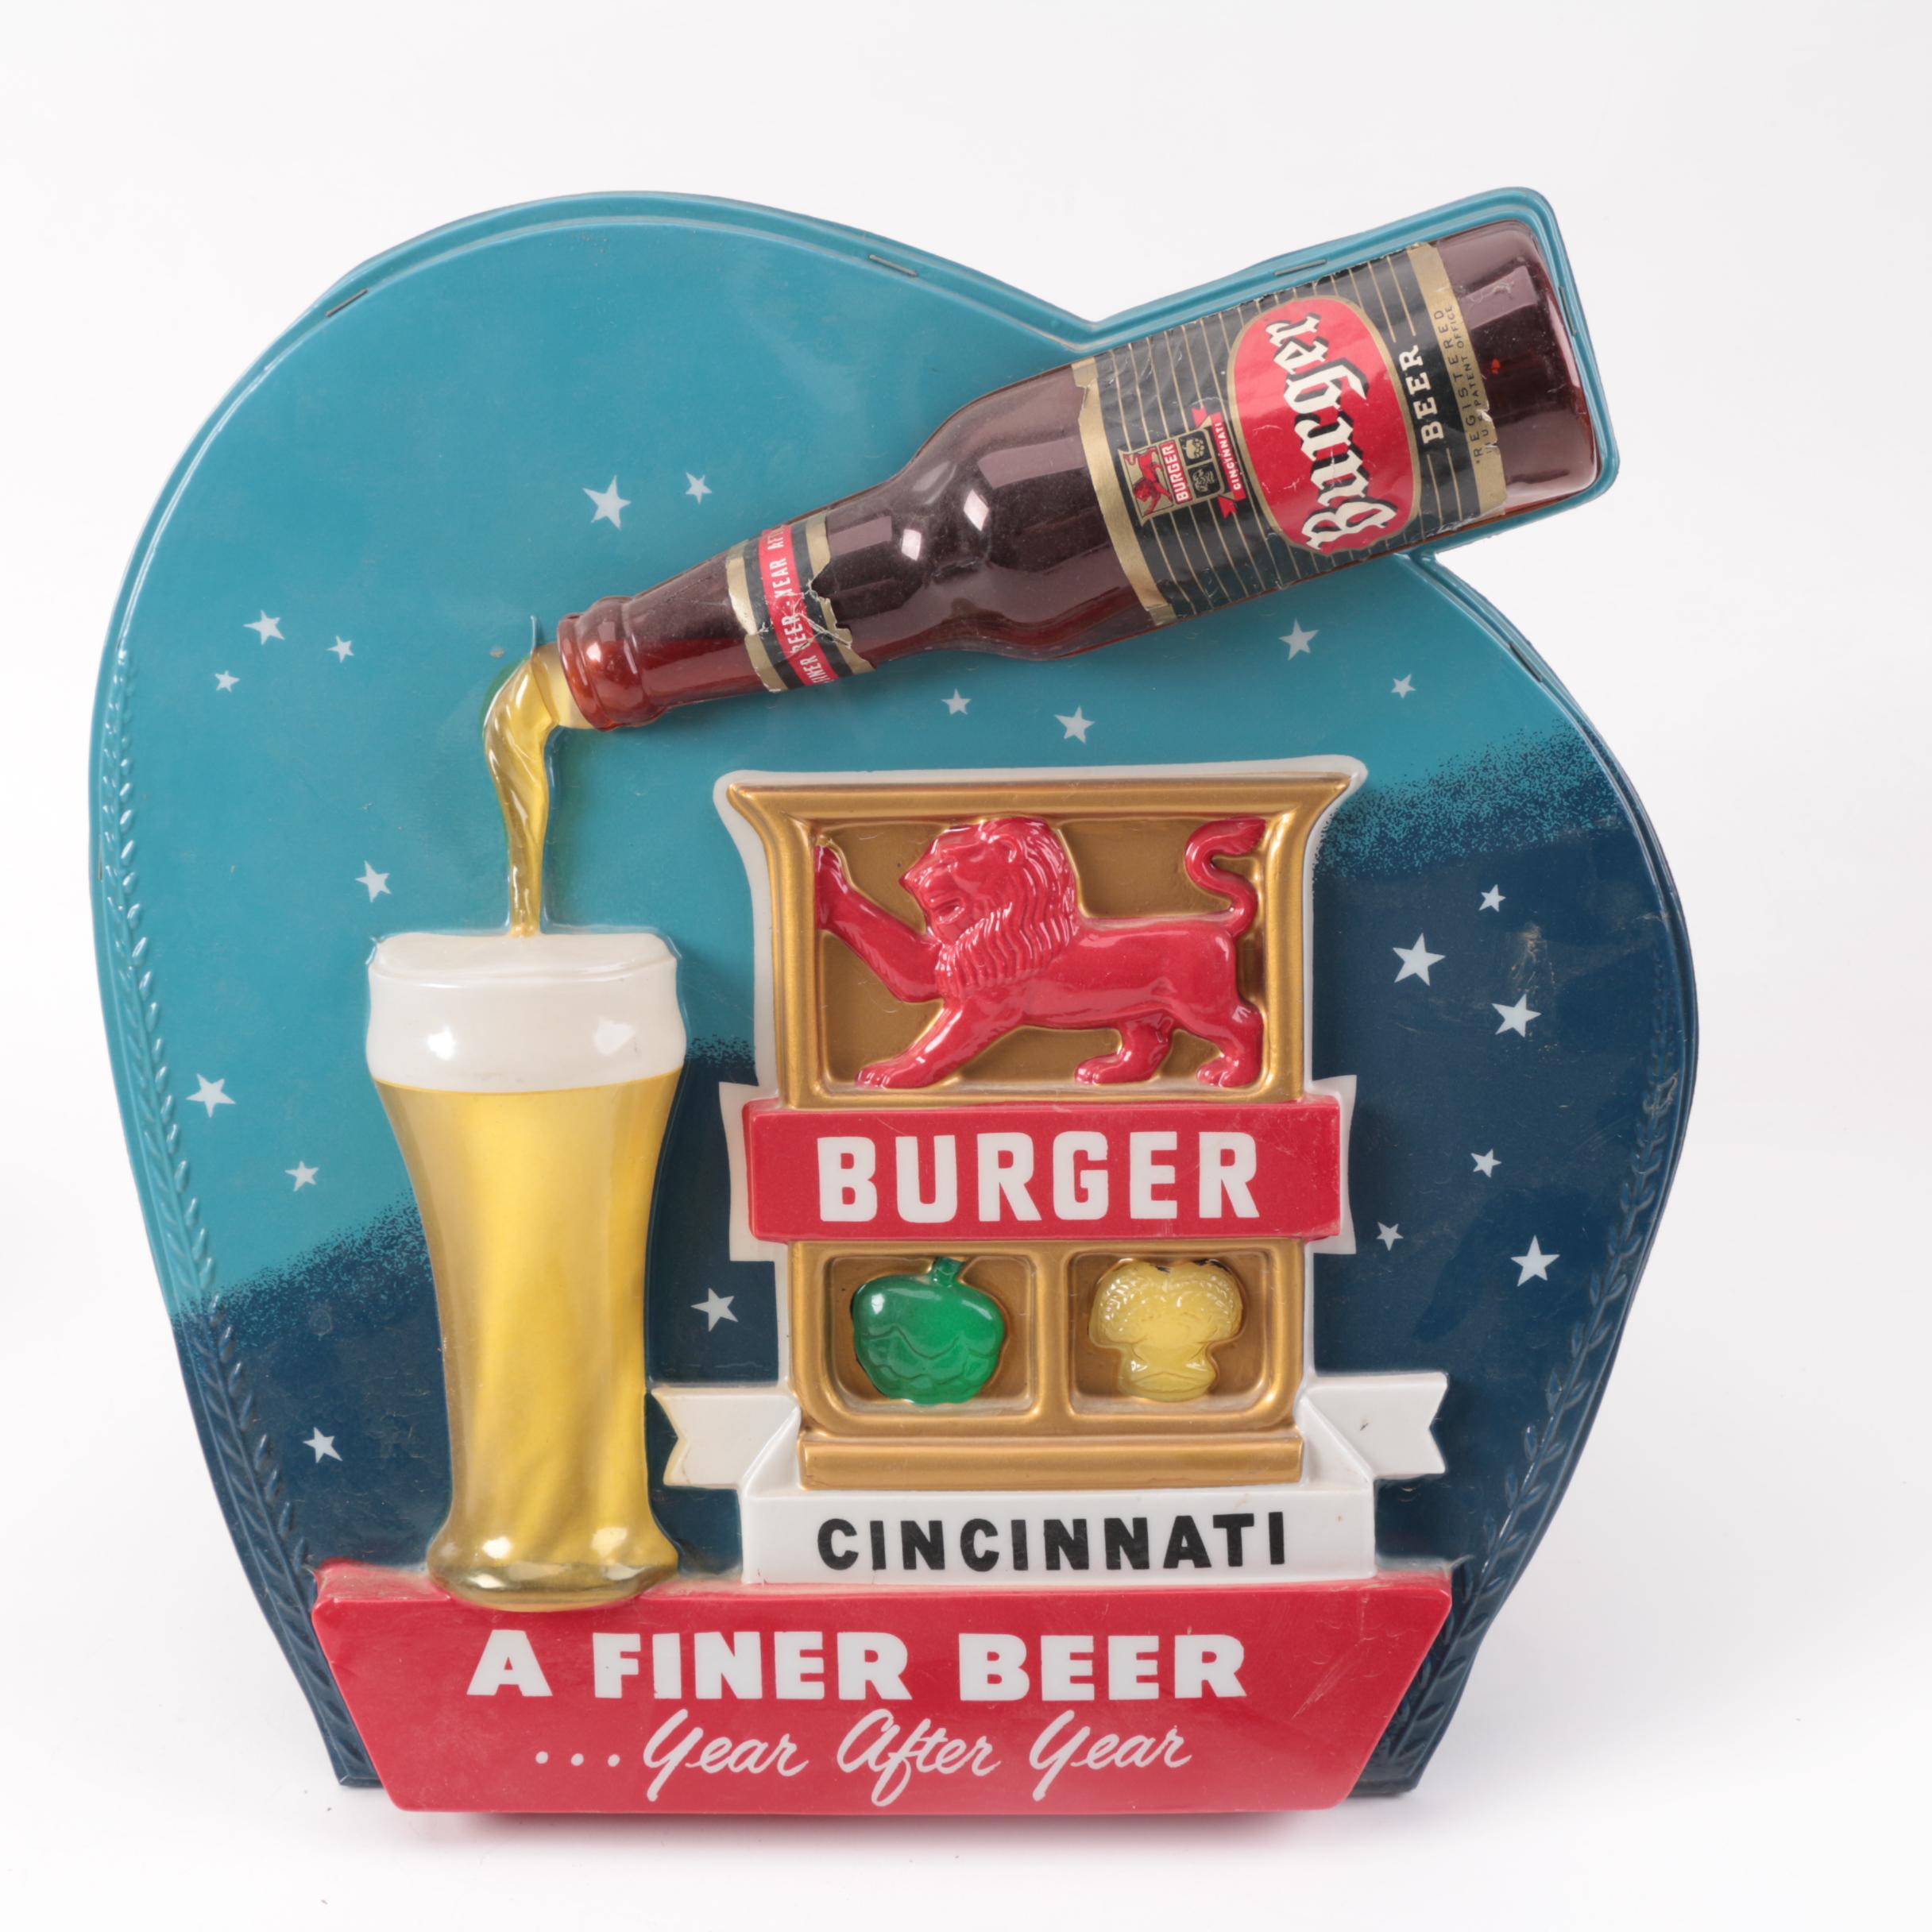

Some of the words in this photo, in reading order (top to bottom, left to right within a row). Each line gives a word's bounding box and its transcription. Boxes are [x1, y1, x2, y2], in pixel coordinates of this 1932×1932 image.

[1445, 306, 1464, 349] OFFICE
[1399, 345, 1445, 445] BEER
[1461, 356, 1482, 406] PATENT
[1265, 311, 1398, 551] Burger
[1161, 443, 1190, 503] BURGER
[769, 557, 794, 600] YEAR
[817, 1131, 1260, 1223] BURGER
[817, 1512, 1286, 1572] CINCINNATI
[466, 1629, 553, 1697] A
[592, 1631, 913, 1700] FINER
[958, 1633, 1247, 1702] BEER
[837, 1708, 1002, 1807] After
[1029, 1710, 1192, 1802] Year
